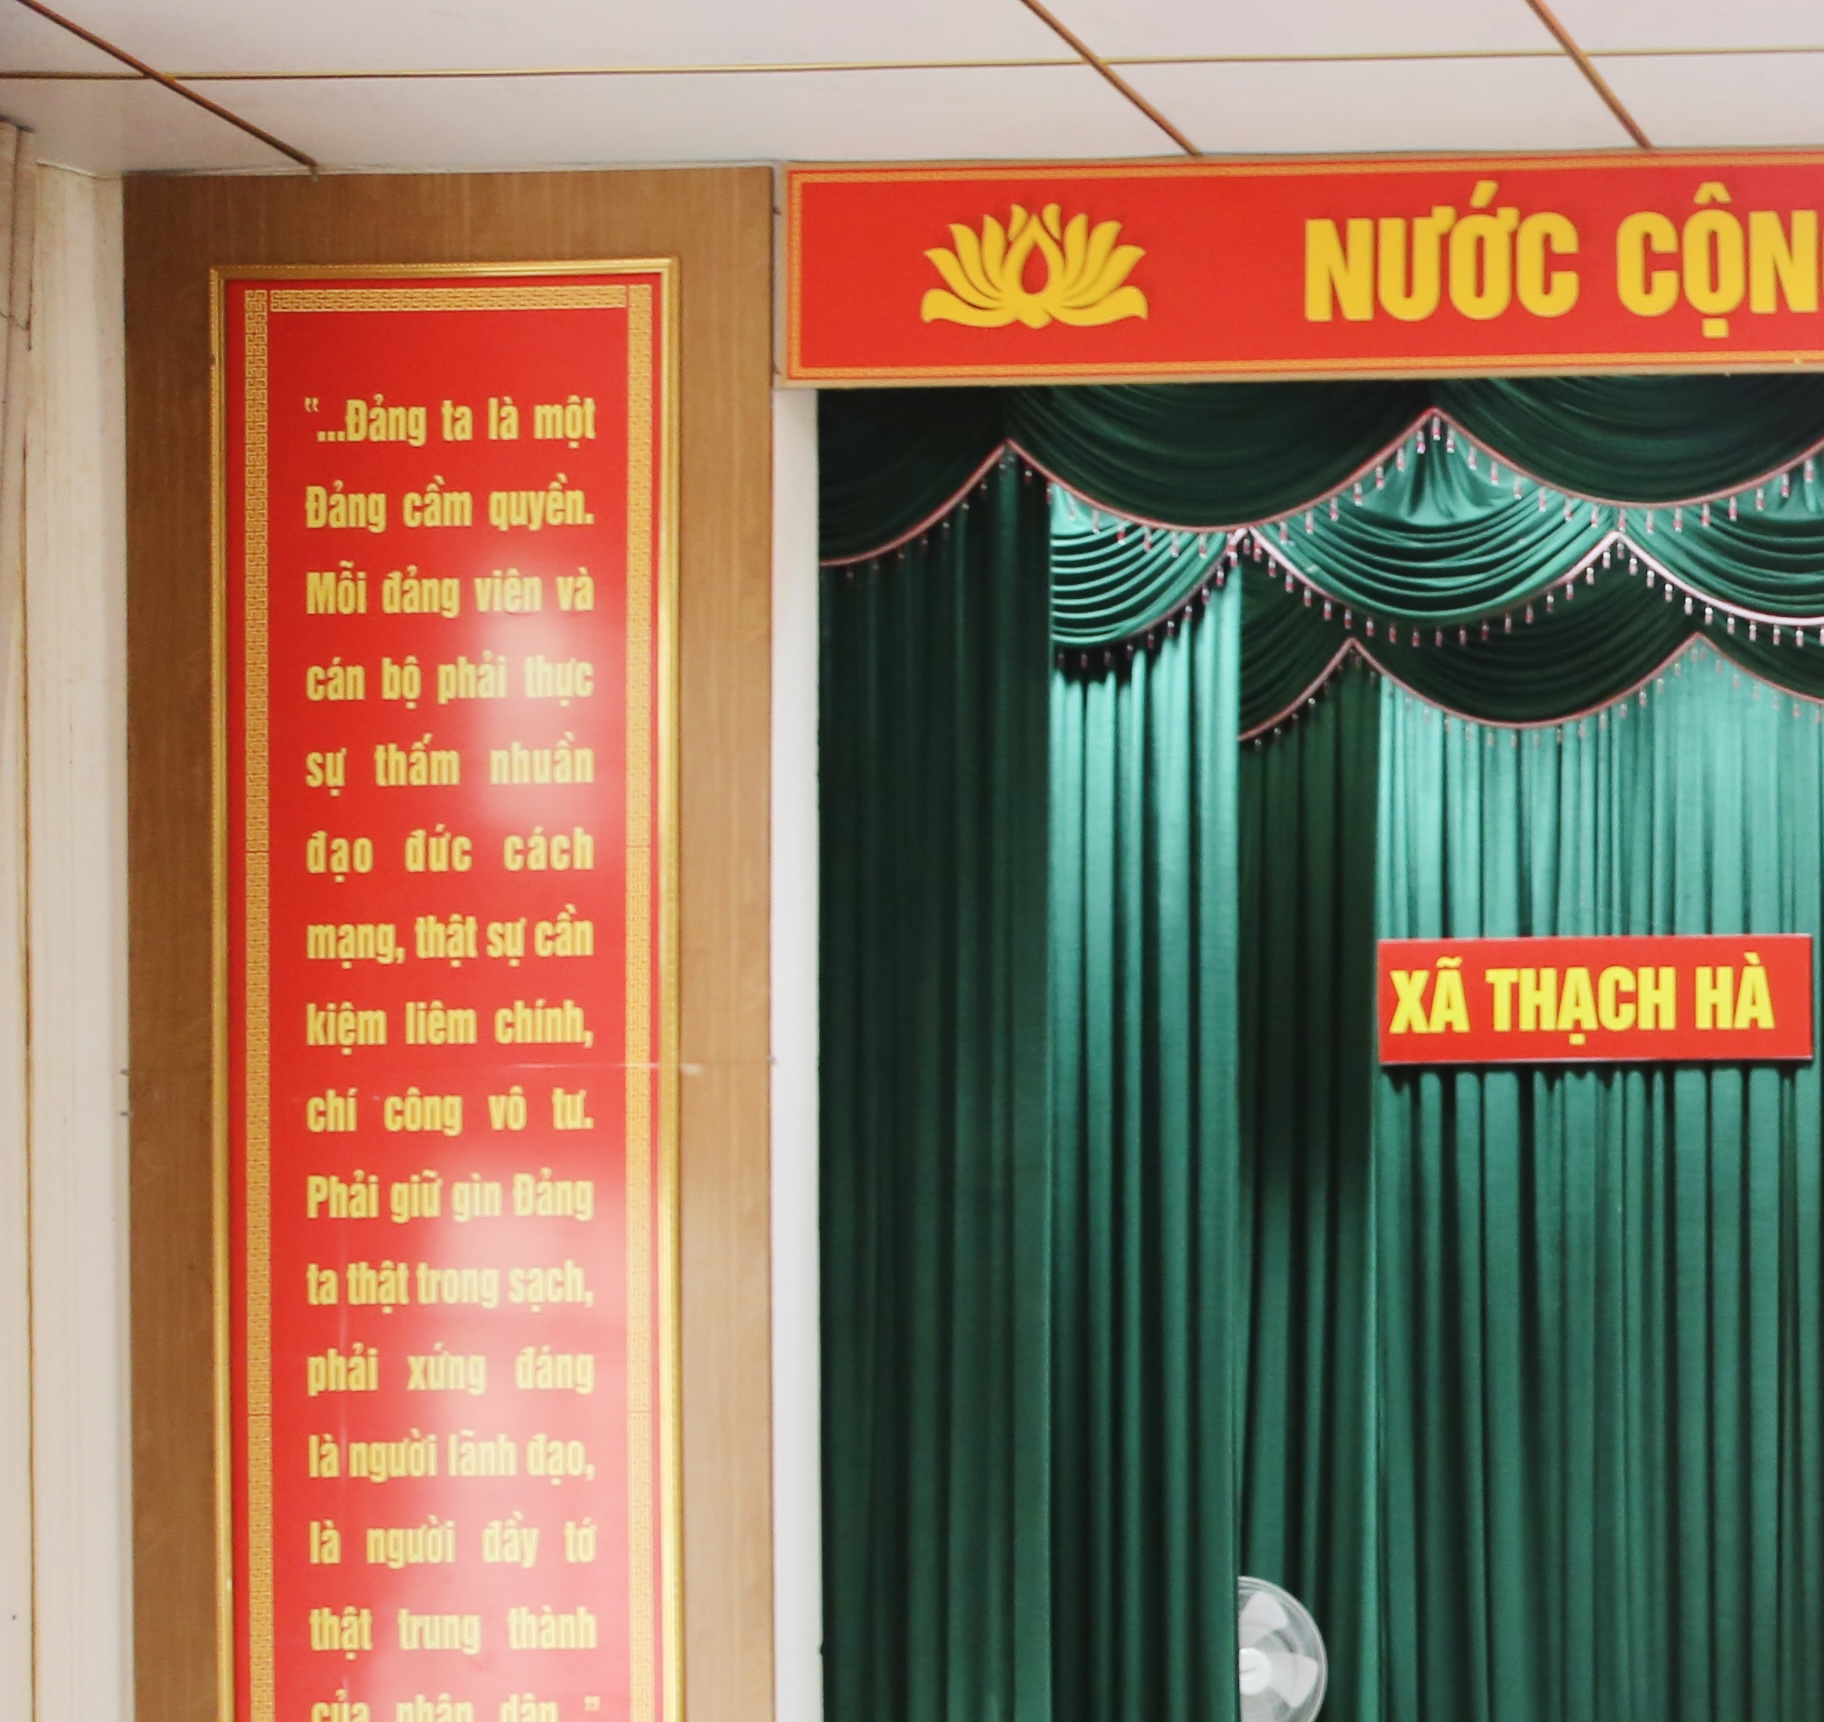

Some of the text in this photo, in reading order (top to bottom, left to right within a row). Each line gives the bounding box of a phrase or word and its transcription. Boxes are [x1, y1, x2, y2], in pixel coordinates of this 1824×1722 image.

[1306, 168, 1579, 321] NƯỚC
[441, 401, 473, 440] ta
[488, 397, 520, 439] là
[533, 395, 596, 447] một
[305, 474, 594, 532] Đảng cầm quyền.
[306, 561, 595, 617] Mỗi đảng viên và
[306, 825, 594, 882] đạo đức cách
[306, 905, 594, 968] mạng, thật sự cần
[1390, 952, 1775, 1045] XÃ THẠCH HÀ
[306, 1000, 593, 1054] kiệm liêm chính,
[306, 1086, 594, 1136] chí công vô tư.
[306, 1168, 594, 1223] Phải giữ gìn Đảng
[309, 1606, 598, 1659] thật trung thành
